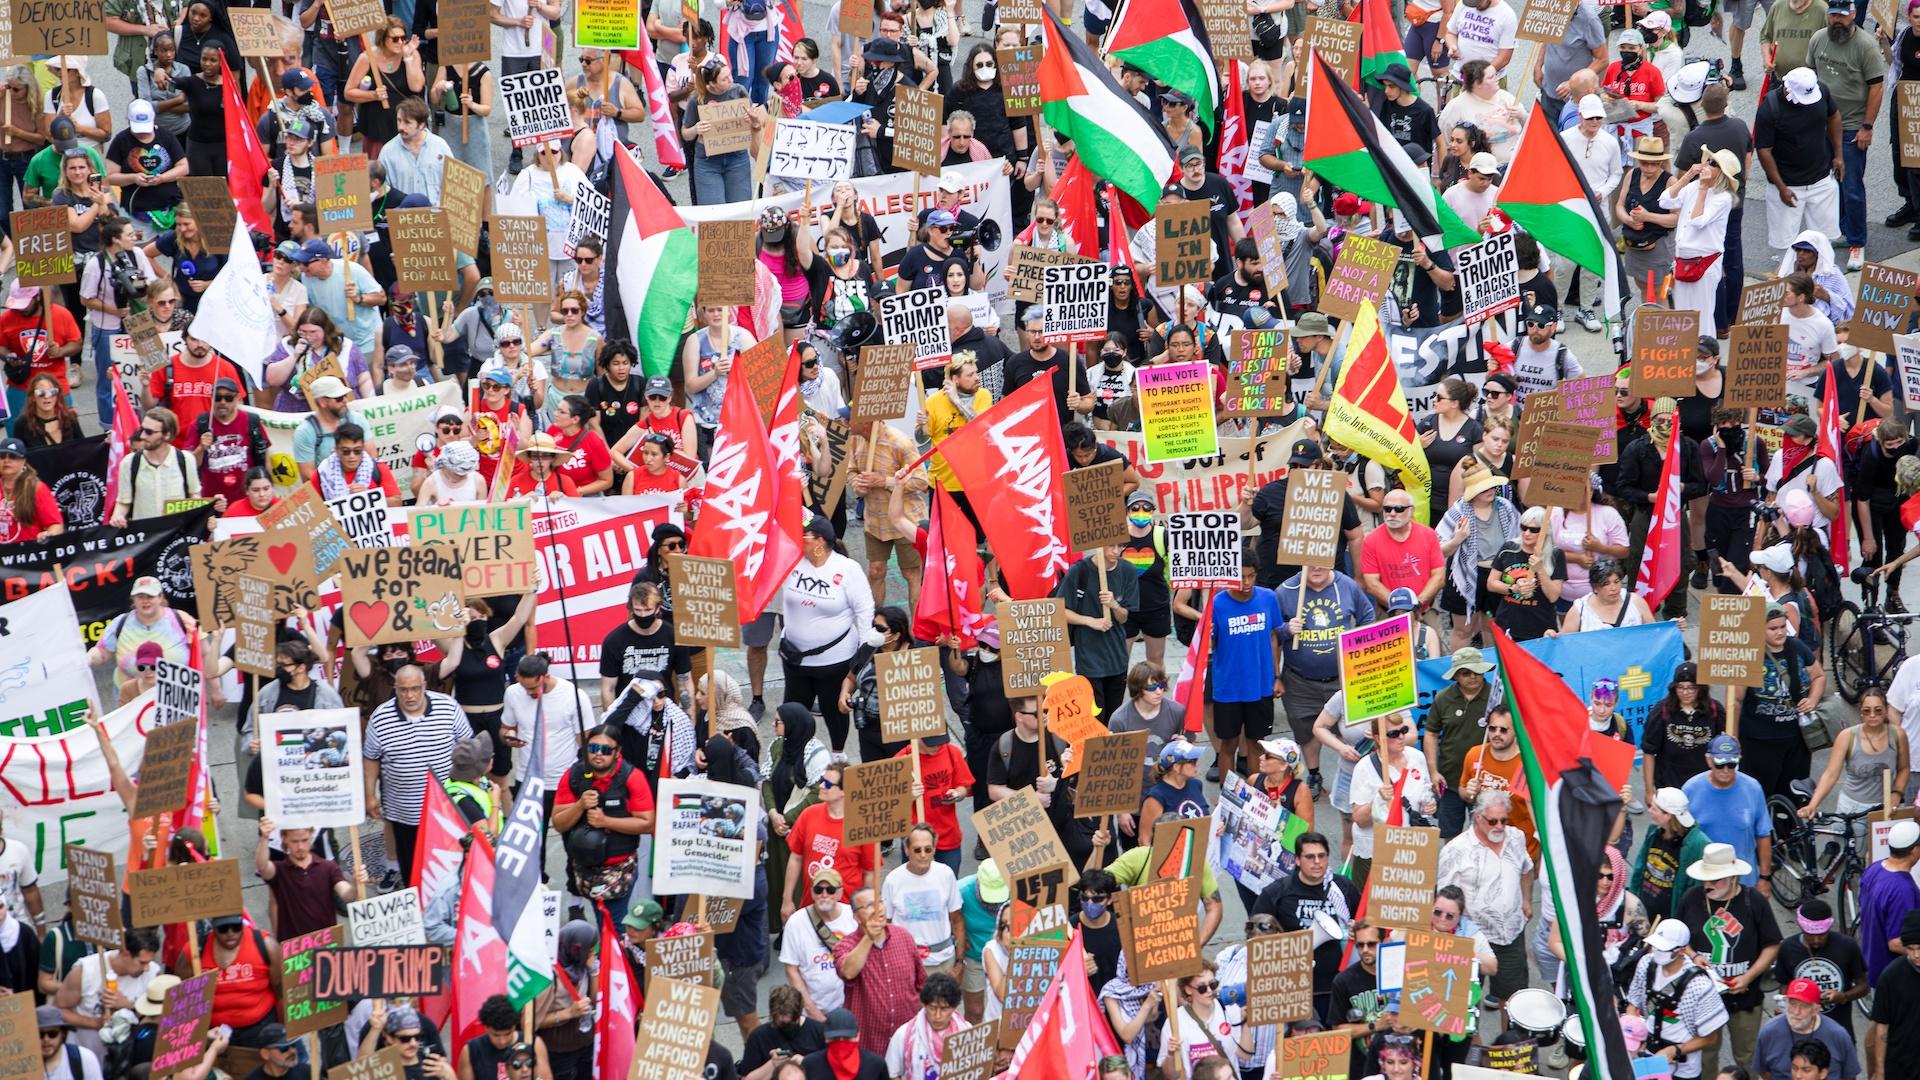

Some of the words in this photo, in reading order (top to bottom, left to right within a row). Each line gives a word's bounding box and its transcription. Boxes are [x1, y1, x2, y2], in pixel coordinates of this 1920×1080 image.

[19, 0, 105, 24] DEMOCRACY
[1464, 10, 1496, 26] BLACK
[1462, 21, 1490, 35] LIVES
[1776, 29, 1813, 39] FUBAR
[38, 26, 91, 50] YES!!
[1459, 30, 1495, 45] MATTER
[501, 70, 559, 92] STOP
[504, 85, 563, 112] TRUMP
[906, 89, 929, 103] WE
[510, 114, 518, 126] &
[522, 104, 567, 125] RACIST
[899, 101, 919, 116] CAN
[920, 105, 936, 120] NO
[511, 117, 570, 137] REPUBLICANS
[897, 116, 935, 135] LONGER
[896, 131, 934, 152] AFFORD
[892, 144, 914, 160] THE
[914, 148, 936, 168] RICH
[319, 195, 358, 210] UNION
[16, 207, 69, 230] FREE
[322, 208, 354, 222] TOWN
[399, 213, 437, 225] PEACE
[498, 220, 538, 231] STAND
[700, 221, 752, 239] PEOPLE
[1164, 216, 1211, 238] LEAD
[396, 228, 444, 240] JUSTICE
[504, 230, 534, 241] WITH
[19, 231, 67, 255] FREE
[409, 243, 435, 254] AND
[496, 242, 544, 256] PALESTINE
[705, 240, 748, 259] OVER
[1177, 243, 1200, 257] IN
[1348, 236, 1377, 253] THIS
[1382, 244, 1395, 258] IS
[16, 254, 74, 277] PALESTINE
[402, 256, 445, 268] EQUITY
[504, 258, 539, 270] STOP
[1019, 250, 1045, 263] NONE
[1047, 253, 1060, 264] OF
[1062, 255, 1076, 265] US
[1339, 250, 1348, 259] A
[1351, 252, 1393, 271] PROTEST
[402, 271, 425, 281] FOR
[428, 270, 451, 281] ALL
[509, 270, 534, 282] THE
[1045, 264, 1108, 283] STOP
[1160, 260, 1209, 282] LOVE
[499, 280, 548, 296] GENOCIDE
[1369, 274, 1378, 287] A
[1045, 282, 1106, 304] TRUMP
[1861, 283, 1909, 308] RIGHTS
[1045, 307, 1054, 321] &
[1059, 301, 1106, 320] RACIST
[1045, 317, 1105, 332] REPUBLICANS
[1642, 316, 1696, 333] STAND
[1861, 309, 1903, 330] NOW
[1240, 331, 1284, 348] STAND
[1655, 335, 1678, 346] UP!
[865, 347, 914, 365] DEFEND
[1242, 347, 1274, 359] WITH
[1640, 348, 1692, 361] FIGHT
[864, 363, 910, 377] WOMEN'S,
[1228, 356, 1287, 374] PALESTINE
[1520, 364, 1544, 376] KEEP
[1643, 365, 1693, 381] BACK!
[1144, 374, 1148, 383] I
[1150, 371, 1172, 382] WILL
[1175, 368, 1199, 380] VOTE
[1239, 372, 1270, 384] STOP
[860, 378, 898, 391] LGBTQ+,
[900, 380, 907, 390] &
[1146, 387, 1159, 397] TO
[1162, 382, 1204, 396] PROTECT:
[1243, 386, 1266, 396] THE
[859, 391, 908, 404] REPRODUCTIVE
[1150, 399, 1181, 409] IMMIGRANT
[1183, 397, 1202, 405] RIGHTS
[1225, 395, 1282, 411] GENOCIDE
[857, 401, 906, 417] RIGHTS
[1180, 405, 1200, 413] RIGHTS
[1148, 416, 1180, 425] AFFORDABLE
[1181, 414, 1194, 422] CARE
[1195, 412, 1208, 420] ACT
[1185, 429, 1204, 437] RIGHTS
[1350, 416, 1397, 453] Internacional
[1177, 437, 1198, 446] CLIMATE
[1166, 446, 1198, 455] DEMOCRACY
[416, 506, 528, 540] PLANET
[1169, 514, 1238, 529] STOP
[1171, 531, 1238, 550] TRUMP
[1, 551, 48, 566] WHAT
[55, 543, 75, 558] DO
[83, 539, 108, 551] WE
[115, 532, 145, 547] DO?
[1172, 553, 1181, 566] &
[1187, 551, 1239, 567] RACIST
[682, 562, 726, 576] STAND
[1172, 567, 1239, 578] REPUBLICANS
[687, 573, 723, 587] WITH
[796, 572, 830, 595] KYR
[373, 578, 420, 600] for
[678, 584, 732, 601] PALESTINE
[686, 601, 725, 613] STOP
[1710, 597, 1751, 612] DEFEND
[392, 601, 414, 632] &
[692, 613, 720, 625] THE
[1228, 612, 1266, 628] BIDEN
[1719, 615, 1740, 628] AND
[679, 624, 734, 641] GENOCIDE
[1229, 622, 1266, 636] HARRIS
[1709, 631, 1750, 645] EXPAND
[1701, 648, 1759, 661] IMMIGRANT
[1710, 665, 1747, 678] RIGHTS
[1056, 699, 1081, 722] ASS
[680, 810, 700, 820] SAVE
[671, 838, 694, 847] Stop
[684, 848, 729, 861] Genocide!
[1016, 869, 1063, 907] LET
[1131, 886, 1164, 903] FIGHT
[1170, 881, 1189, 895] THE
[352, 901, 377, 923] NO
[381, 892, 417, 915] WAR
[1138, 893, 1188, 917] RACIST
[1150, 908, 1174, 924] AND
[354, 911, 417, 941] CRIMINAL
[1134, 914, 1197, 939] REACTIONARY
[1135, 930, 1193, 953] REPUBLICAN
[1408, 934, 1429, 947] UP
[1433, 937, 1454, 951] UP
[1014, 947, 1060, 961] DEFEND
[1145, 943, 1197, 968] AGENDA
[1435, 951, 1469, 966] WITH
[315, 948, 376, 1000] DUMP
